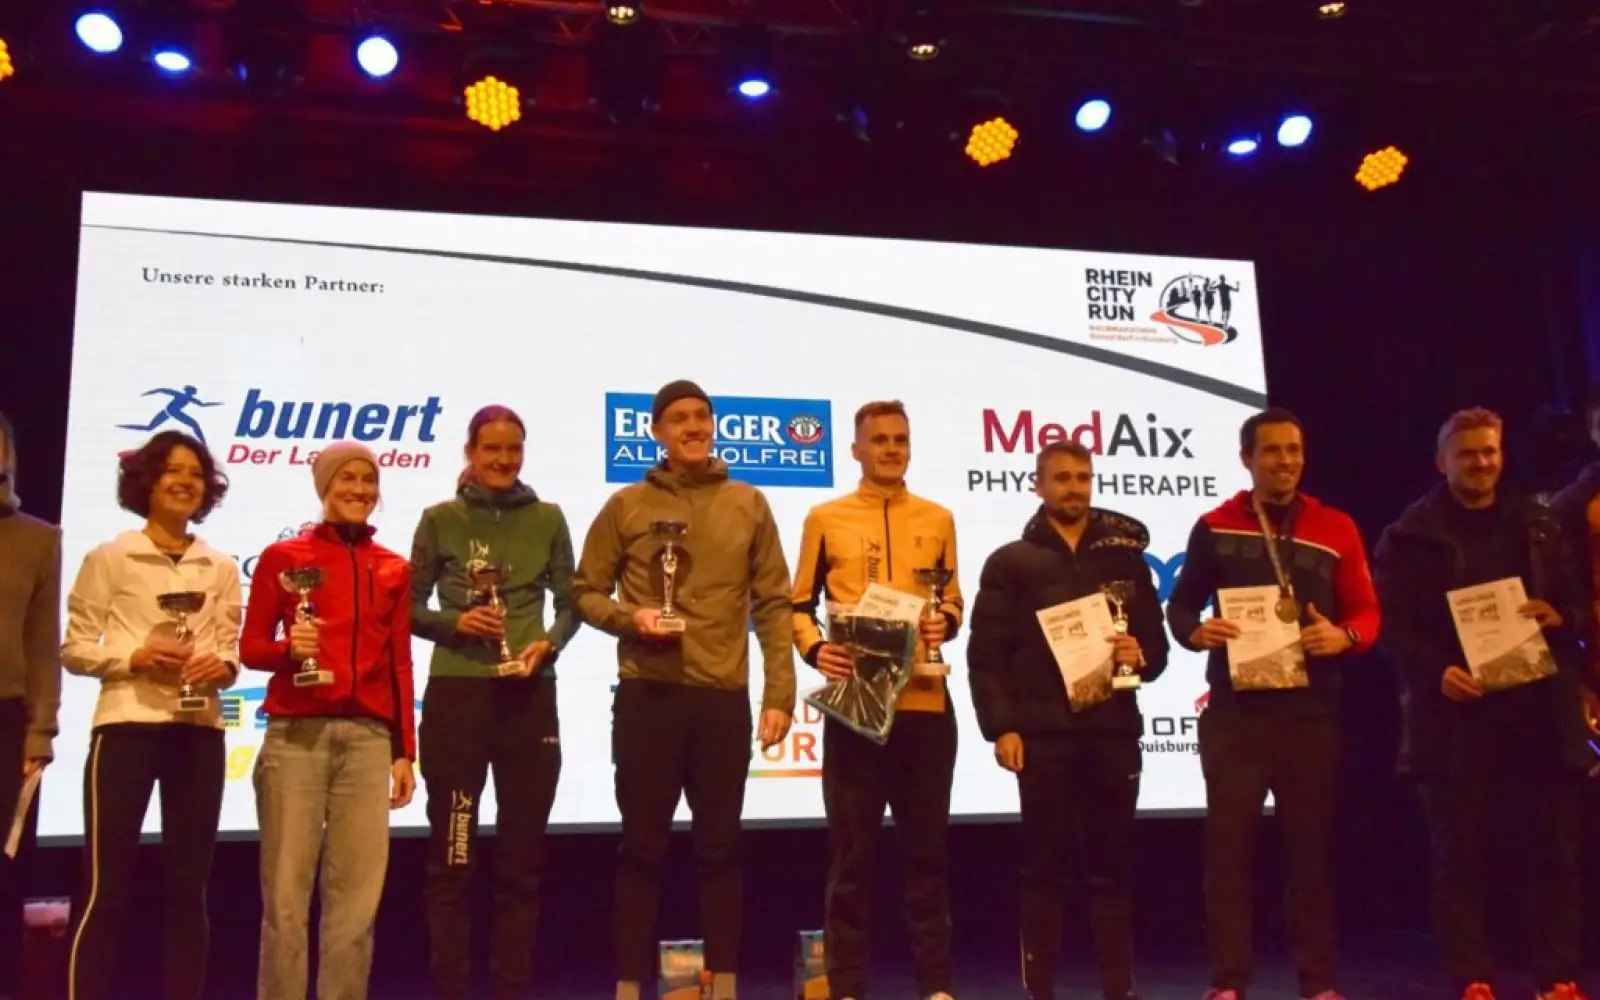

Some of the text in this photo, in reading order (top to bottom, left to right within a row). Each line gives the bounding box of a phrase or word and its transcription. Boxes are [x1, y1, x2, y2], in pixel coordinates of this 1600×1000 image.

[141, 267, 385, 294] Unsere starken Partner:
[1085, 268, 1153, 288] RHEIN
[1086, 286, 1135, 303] CITY
[1088, 303, 1135, 321] RUN
[234, 388, 443, 443] bunert
[613, 407, 786, 445] ERGER
[982, 408, 1195, 459] MedAix
[227, 444, 431, 469] Der Laden
[613, 445, 825, 466] ALKHOLFREI
[967, 469, 1218, 497] PHYSHERAPIE
